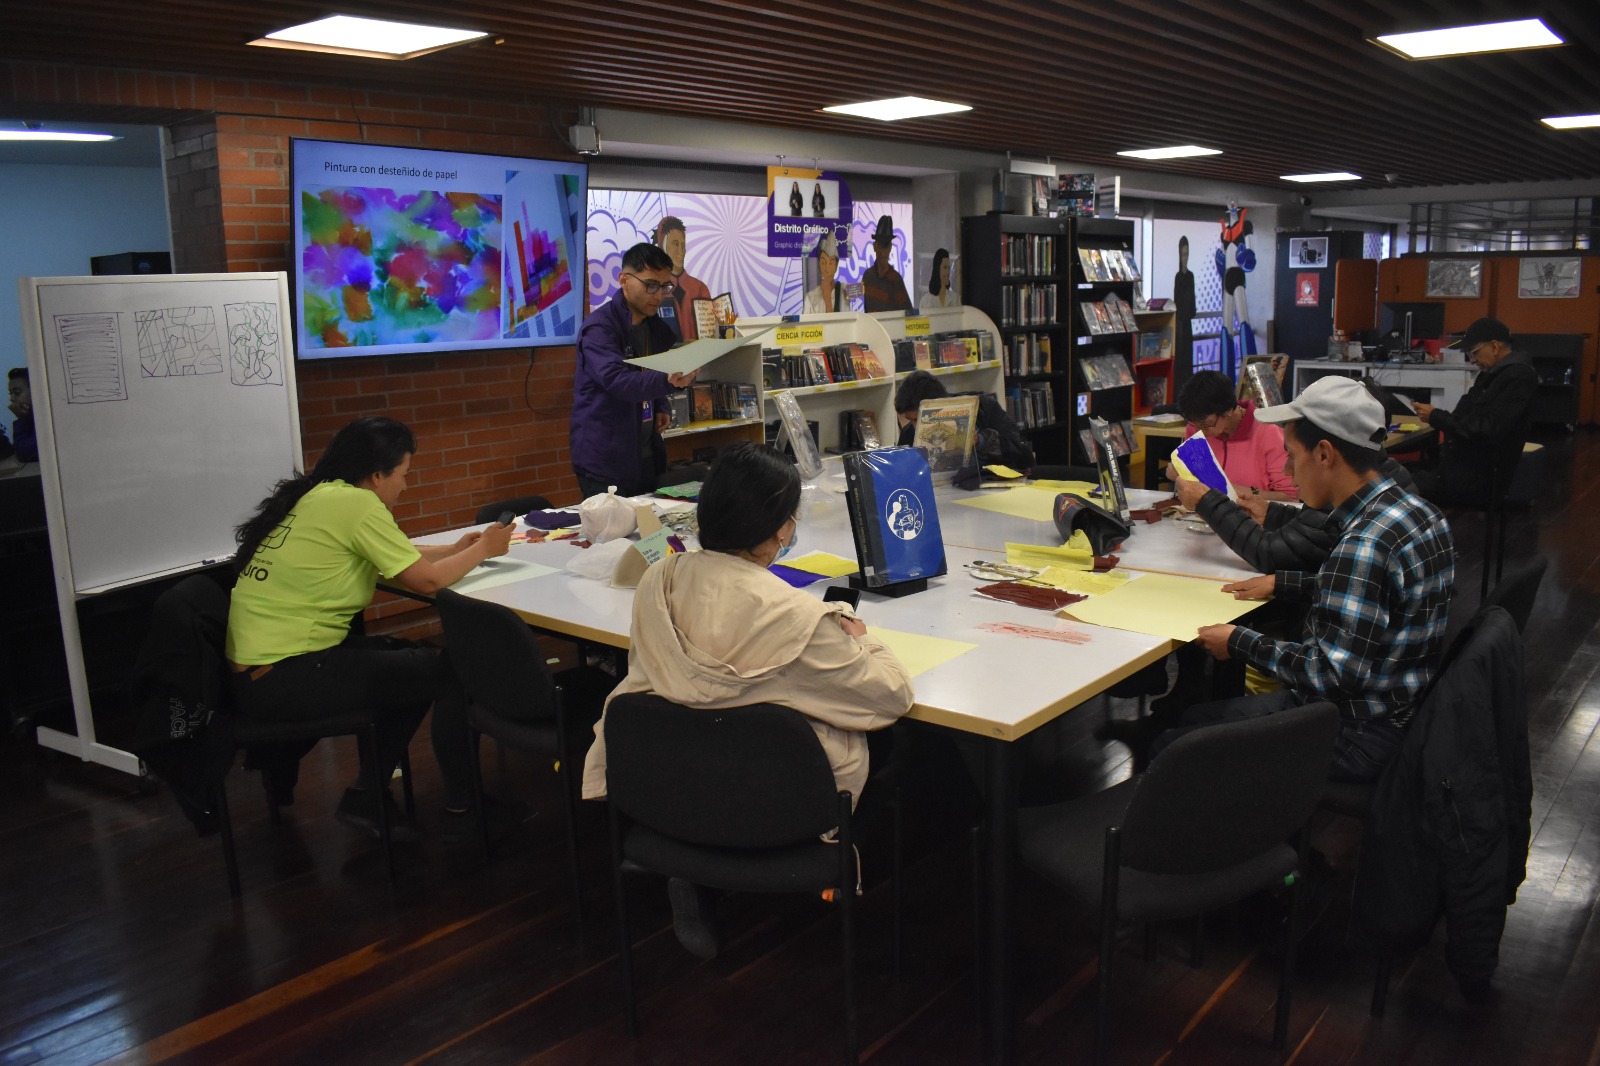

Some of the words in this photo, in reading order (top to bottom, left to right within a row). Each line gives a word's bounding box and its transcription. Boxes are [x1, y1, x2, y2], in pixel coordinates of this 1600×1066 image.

[324, 161, 357, 173] Pintura
[360, 164, 376, 174] con
[378, 165, 421, 177] desteñido
[422, 168, 433, 178] de
[435, 170, 458, 180] papel
[774, 223, 802, 234] Distrito
[803, 224, 829, 235] Gráfico
[774, 241, 793, 250] Graphic
[905, 322, 930, 331] HISTÓRICO
[776, 332, 799, 341] CIENCIA
[800, 329, 823, 339] FICCIÓN
